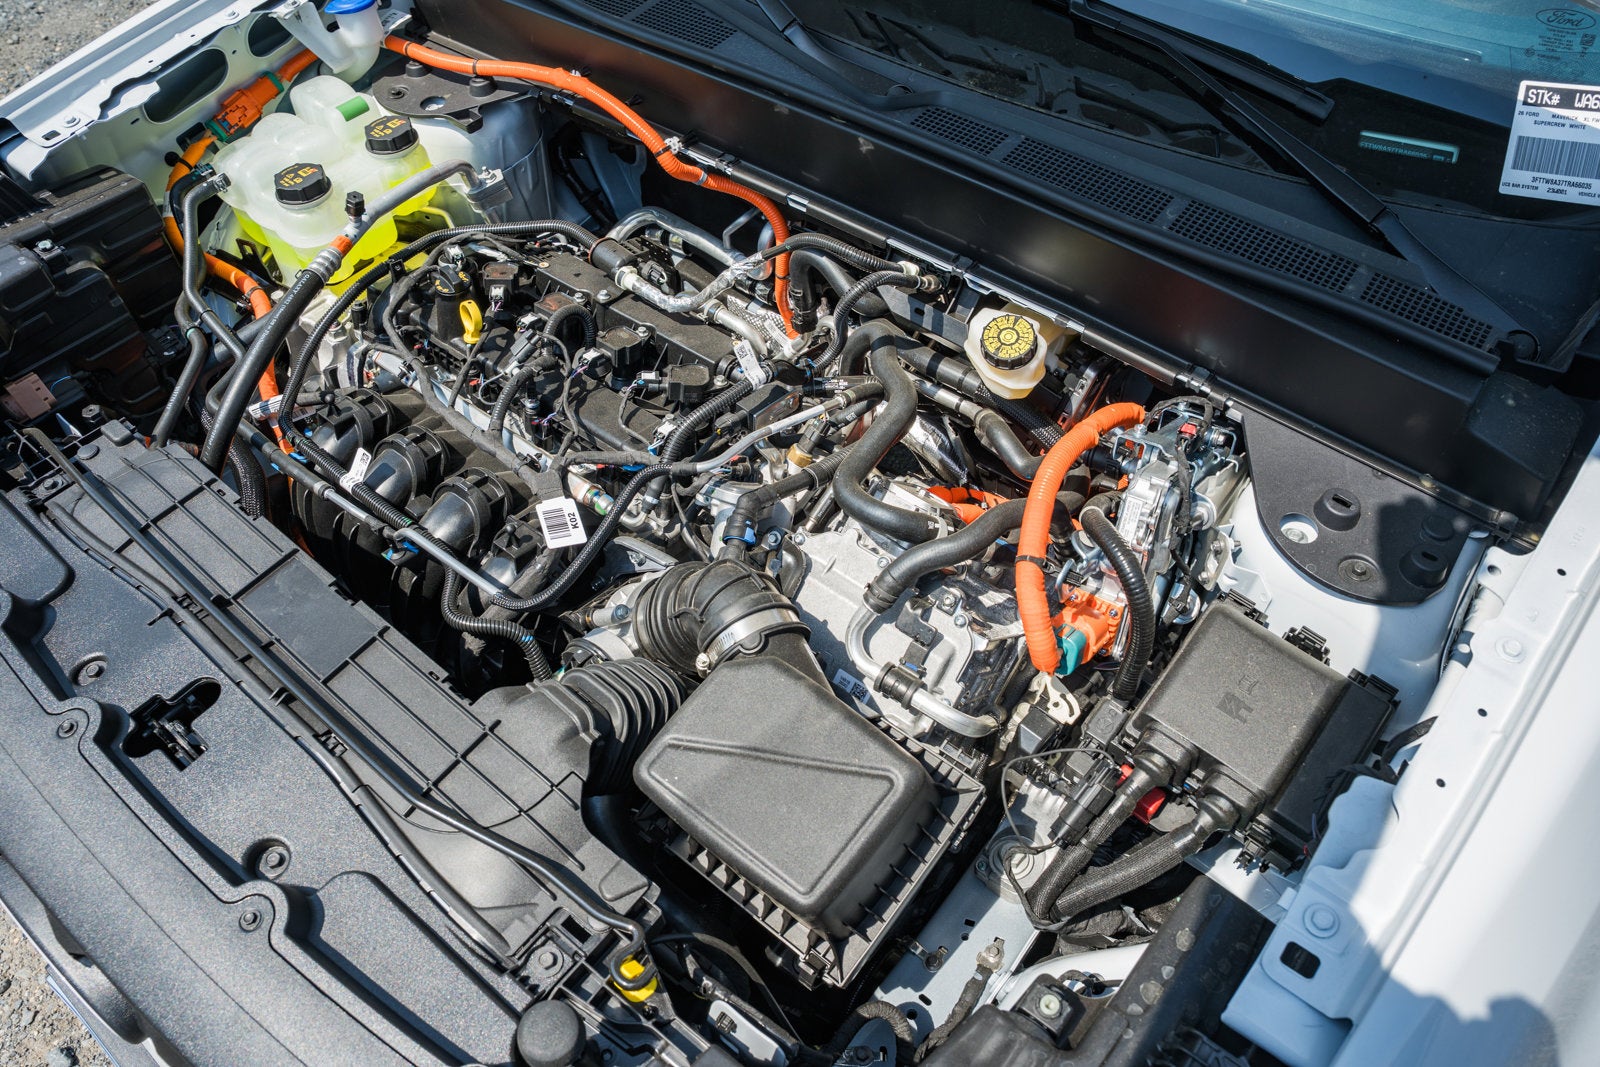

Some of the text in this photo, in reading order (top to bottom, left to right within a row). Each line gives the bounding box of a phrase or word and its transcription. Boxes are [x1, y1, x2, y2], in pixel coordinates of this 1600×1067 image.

[1546, 10, 1585, 27] Ford
[1527, 88, 1600, 109] STK# WA6
[1533, 120, 1567, 128] SUPERCREW
[568, 512, 579, 529] K02
